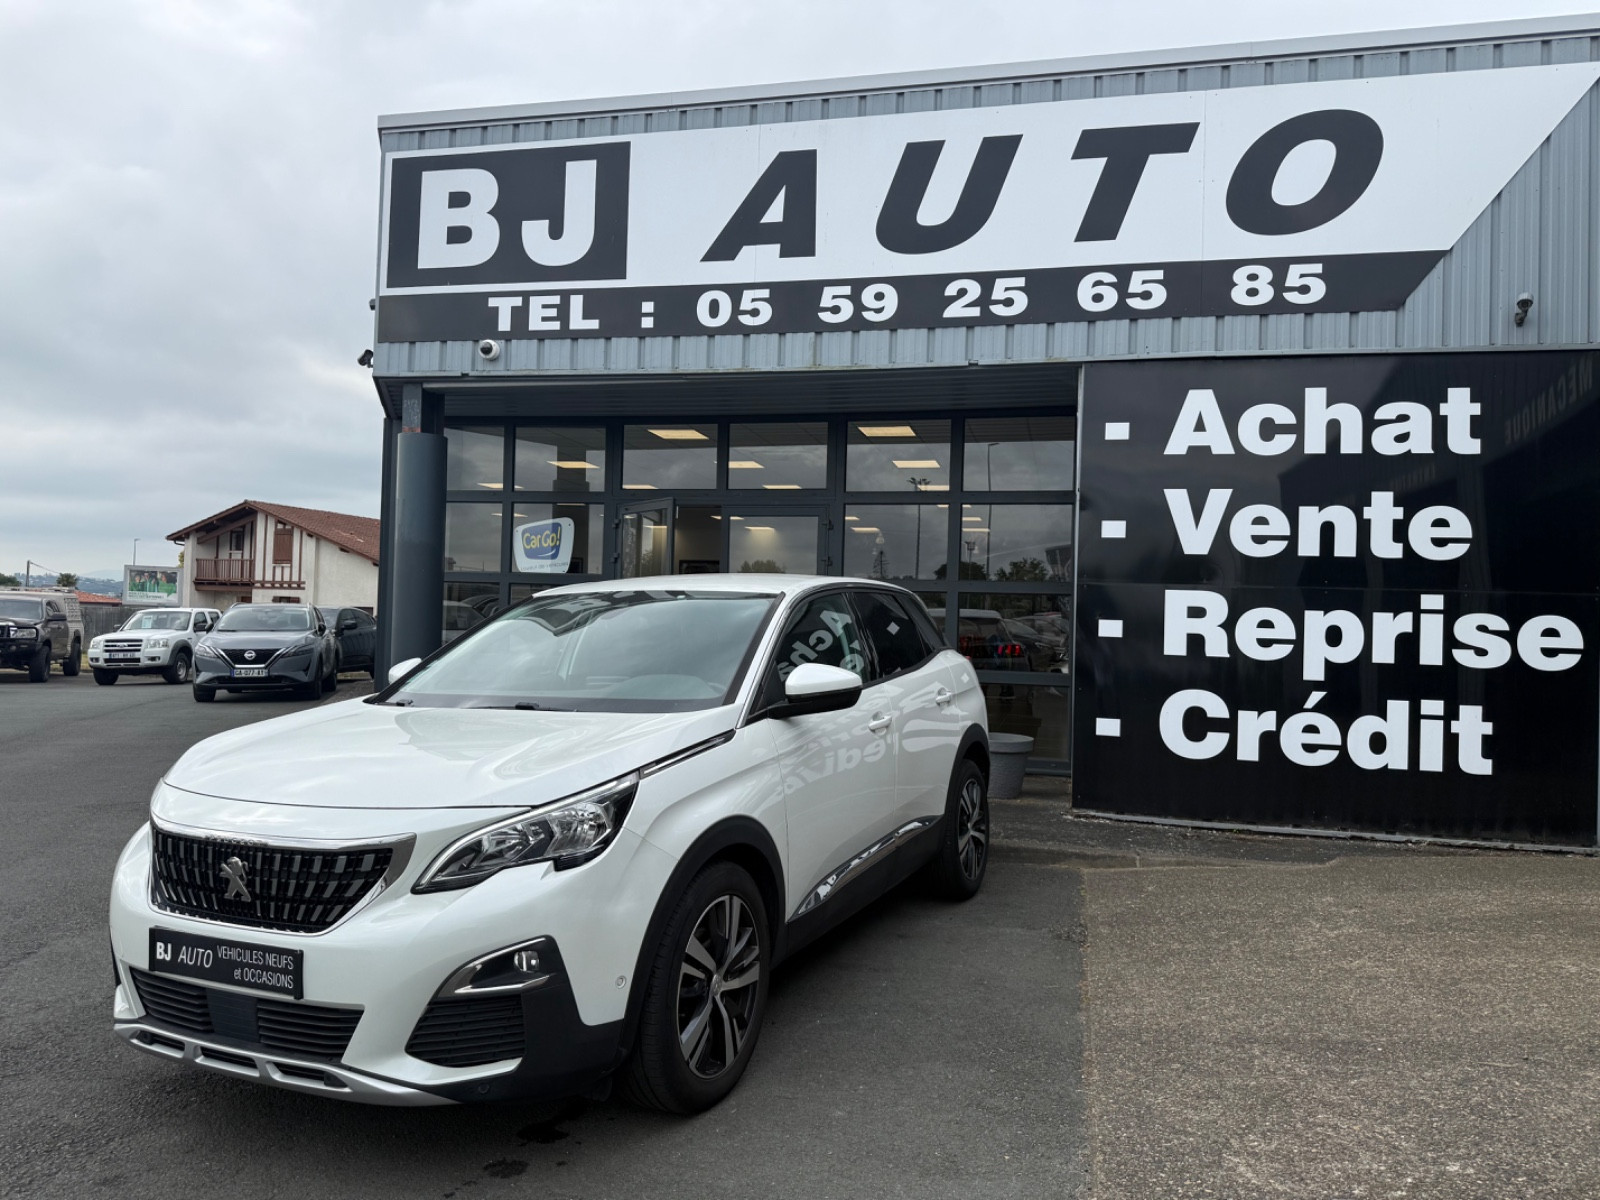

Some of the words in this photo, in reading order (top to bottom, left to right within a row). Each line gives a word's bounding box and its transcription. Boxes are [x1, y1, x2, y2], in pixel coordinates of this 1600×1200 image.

[418, 160, 597, 270] BJ
[700, 109, 1383, 262] AUTO
[488, 294, 600, 332] TEL
[696, 288, 773, 327] 05
[818, 284, 899, 324] 59
[943, 276, 1029, 318] 25
[1077, 270, 1168, 312] 65
[1231, 263, 1326, 306] 85
[1164, 386, 1481, 456] Achat
[1164, 489, 1473, 561] Vente
[1163, 589, 1584, 682] Reprise
[1159, 689, 1493, 776] Crédit
[156, 941, 172, 961] BJ
[178, 945, 213, 968] AUTO
[217, 945, 263, 965] VEHICULES
[265, 953, 294, 970] NEUFS
[233, 967, 241, 980] et
[243, 967, 294, 989] OCCASIONS
